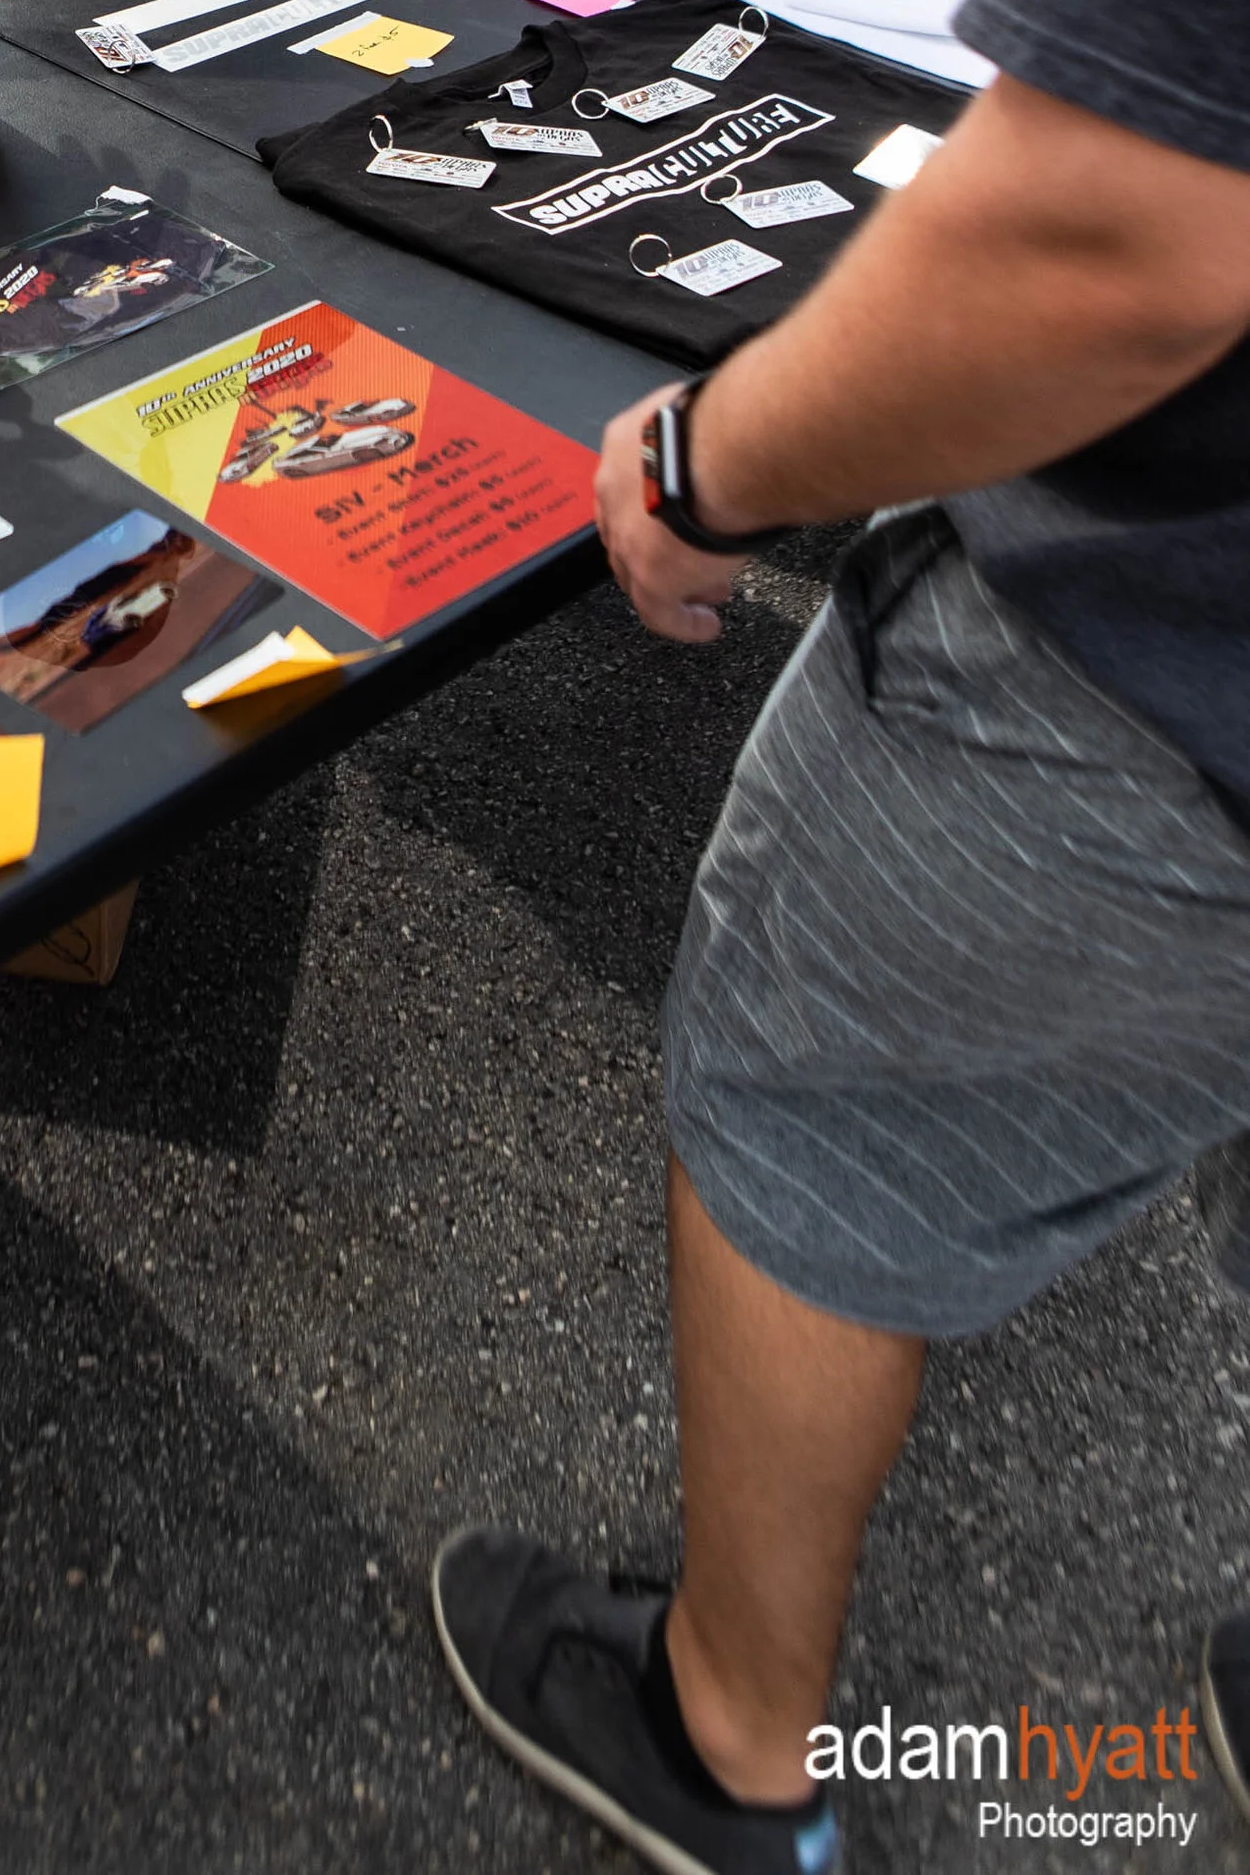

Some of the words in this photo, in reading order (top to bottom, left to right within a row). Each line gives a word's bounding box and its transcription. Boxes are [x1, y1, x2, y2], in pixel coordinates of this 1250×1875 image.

[2, 264, 40, 300] 2020
[141, 375, 246, 438] SUPRAS
[246, 342, 313, 386] 2020
[181, 335, 297, 397] ANNIVERSARY
[387, 436, 479, 486] Merch
